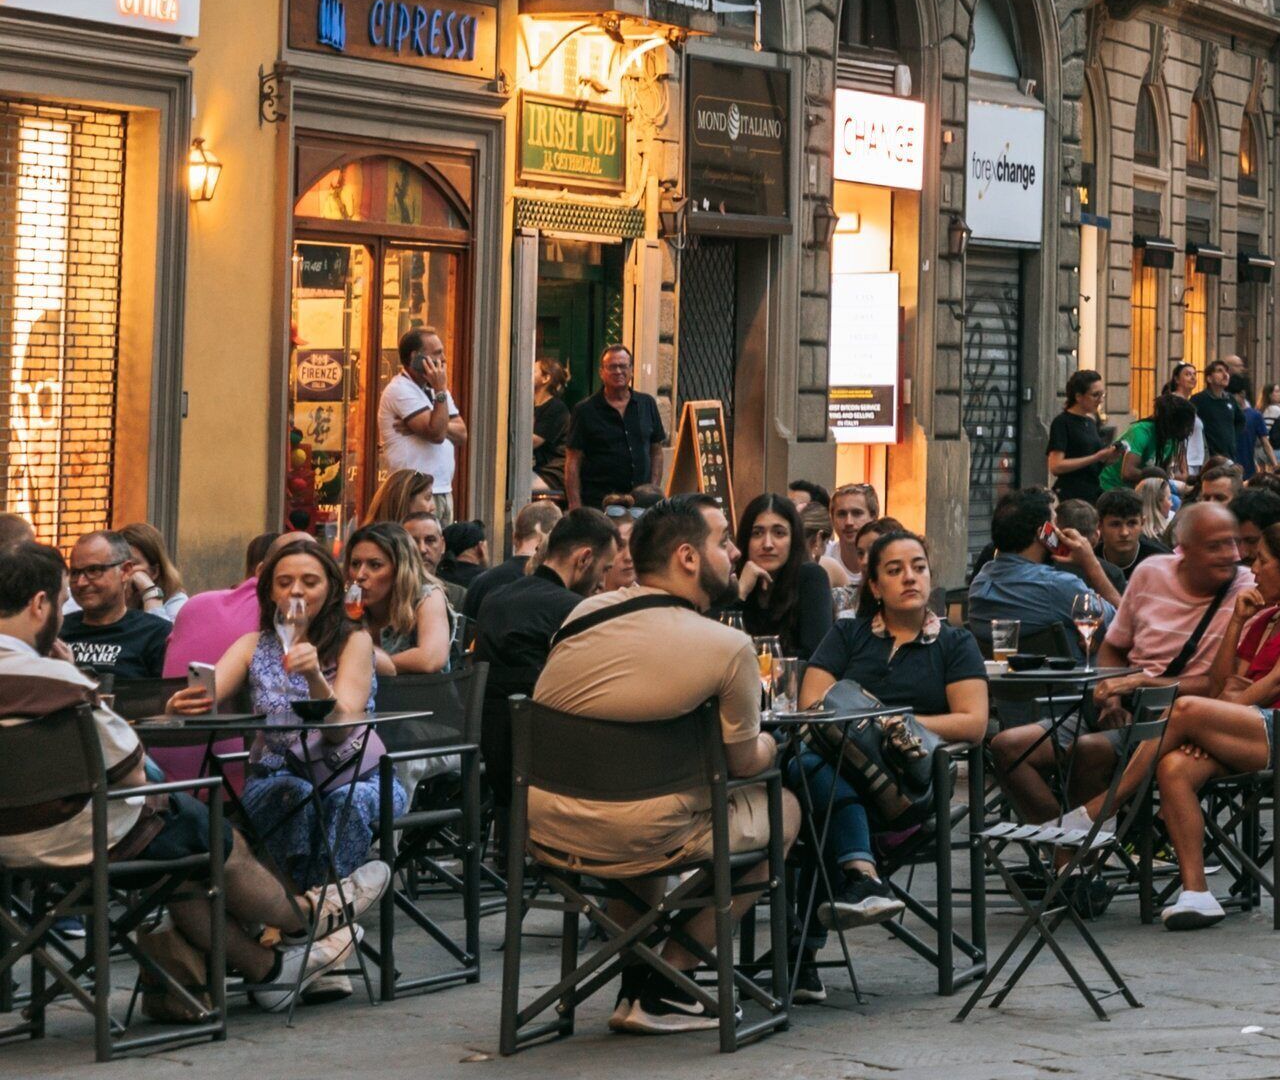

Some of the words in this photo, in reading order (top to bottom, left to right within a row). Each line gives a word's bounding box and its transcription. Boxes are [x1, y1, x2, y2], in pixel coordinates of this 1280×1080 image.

[527, 104, 578, 152] IRISH
[582, 112, 617, 156] PUB
[301, 366, 337, 380] FIRENZE
[69, 642, 121, 653] GNANDO
[76, 652, 118, 662] MARE
